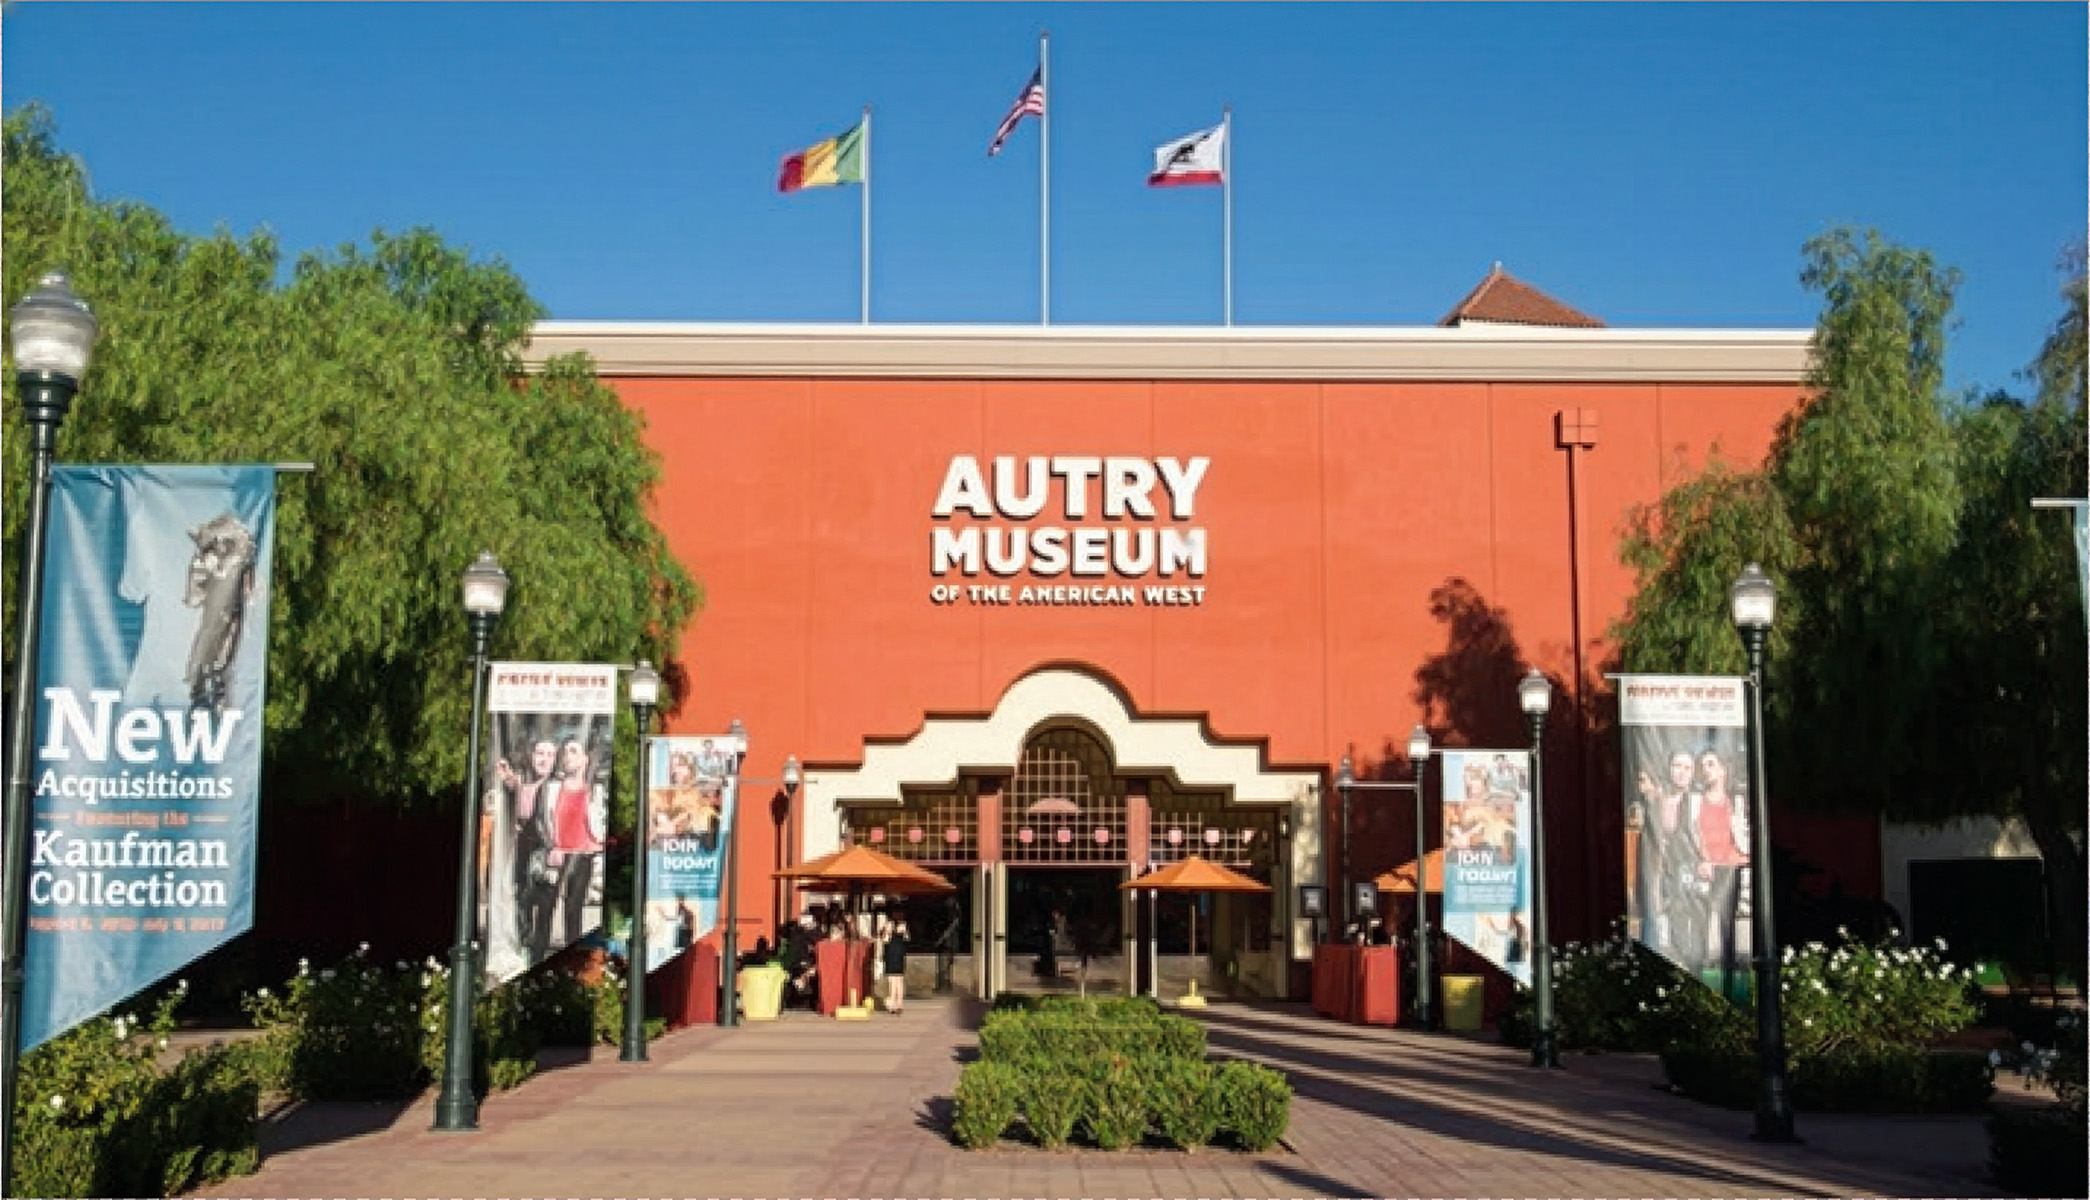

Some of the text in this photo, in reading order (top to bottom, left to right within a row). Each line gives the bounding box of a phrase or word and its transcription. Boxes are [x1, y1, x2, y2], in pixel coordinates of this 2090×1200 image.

[932, 455, 1210, 518] AUTRY
[932, 527, 1207, 576] MUSEUM
[931, 584, 1205, 603] OF THE AMERICAN WEST
[38, 687, 244, 763] New
[35, 769, 233, 804] Acquisitions
[32, 830, 229, 868] Kaufman
[30, 871, 227, 906] Collection
